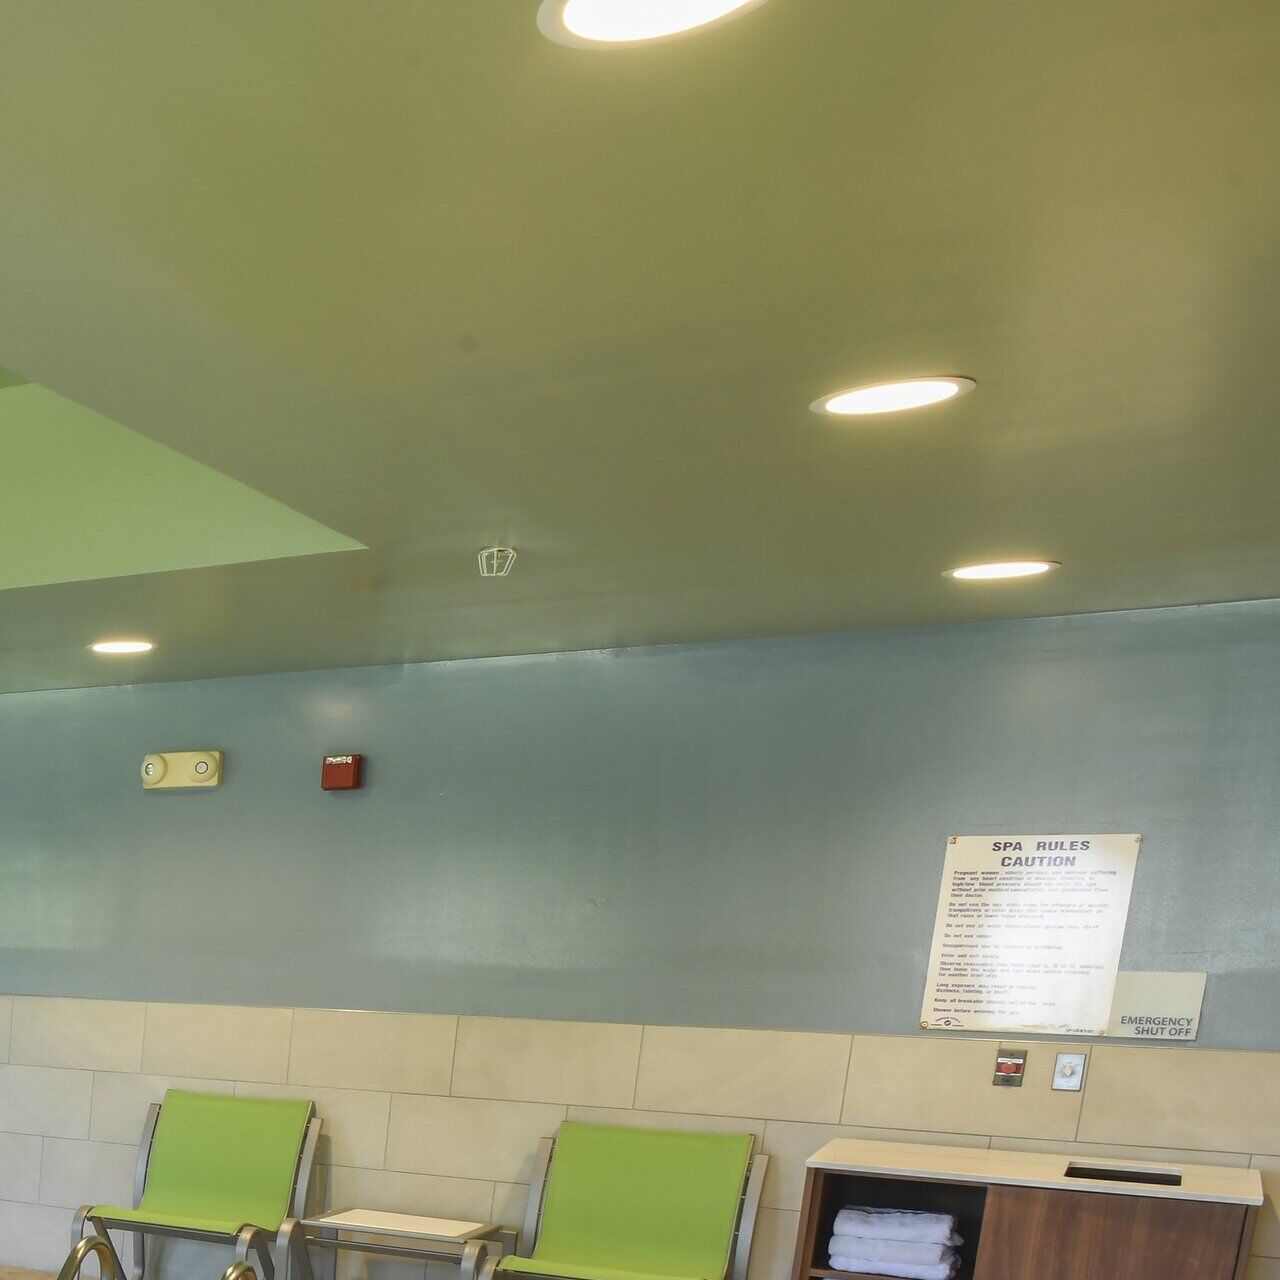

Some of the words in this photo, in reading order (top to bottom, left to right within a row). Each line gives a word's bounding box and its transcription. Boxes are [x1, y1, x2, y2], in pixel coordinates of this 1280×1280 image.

[992, 841, 1022, 852] SPA
[1036, 840, 1090, 851] RULES
[1000, 856, 1077, 867] CAUTION
[1120, 1016, 1193, 1026] EMERGENCY
[1134, 1026, 1166, 1036] SHUT
[1168, 1028, 1192, 1036] OFF
